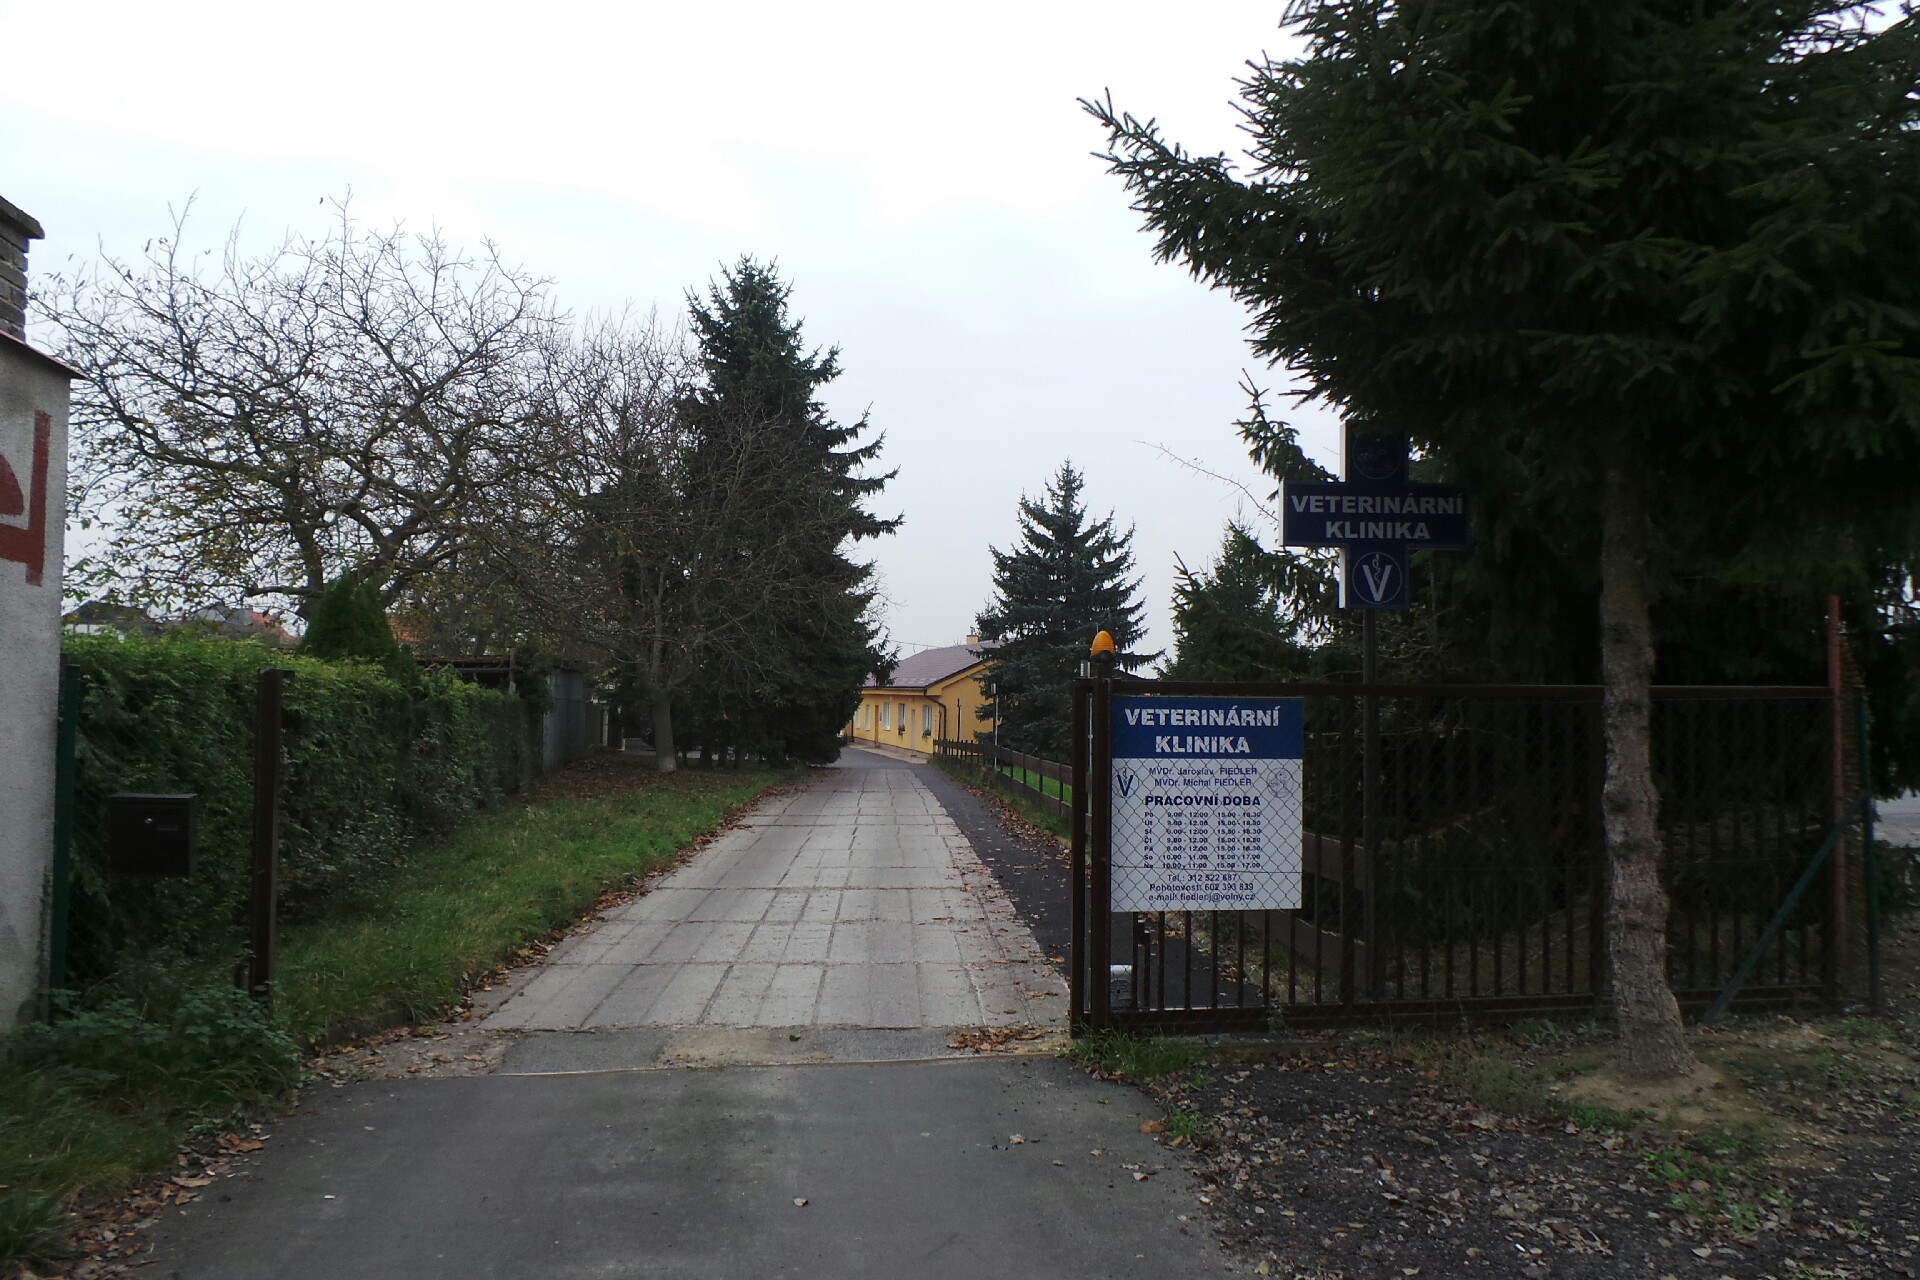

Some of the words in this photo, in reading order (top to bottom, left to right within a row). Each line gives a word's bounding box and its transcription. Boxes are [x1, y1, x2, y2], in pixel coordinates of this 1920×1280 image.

[1291, 492, 1464, 514] VETERINÁRNÍ
[1326, 521, 1430, 539] KLINIKA
[1124, 705, 1281, 727] VETERINÁRNÍ
[1155, 736, 1250, 753] KLINIKA
[1149, 767, 1174, 775] MVDr.
[1177, 767, 1213, 775] Jaroslav
[1220, 767, 1257, 775] FIEDLER
[1155, 778, 1180, 786] MVDr.
[1183, 778, 1211, 786] Michal
[1215, 778, 1252, 786] FIEDLER
[1145, 793, 1218, 806] PRACOVNÍ
[1223, 796, 1260, 806] DOBA
